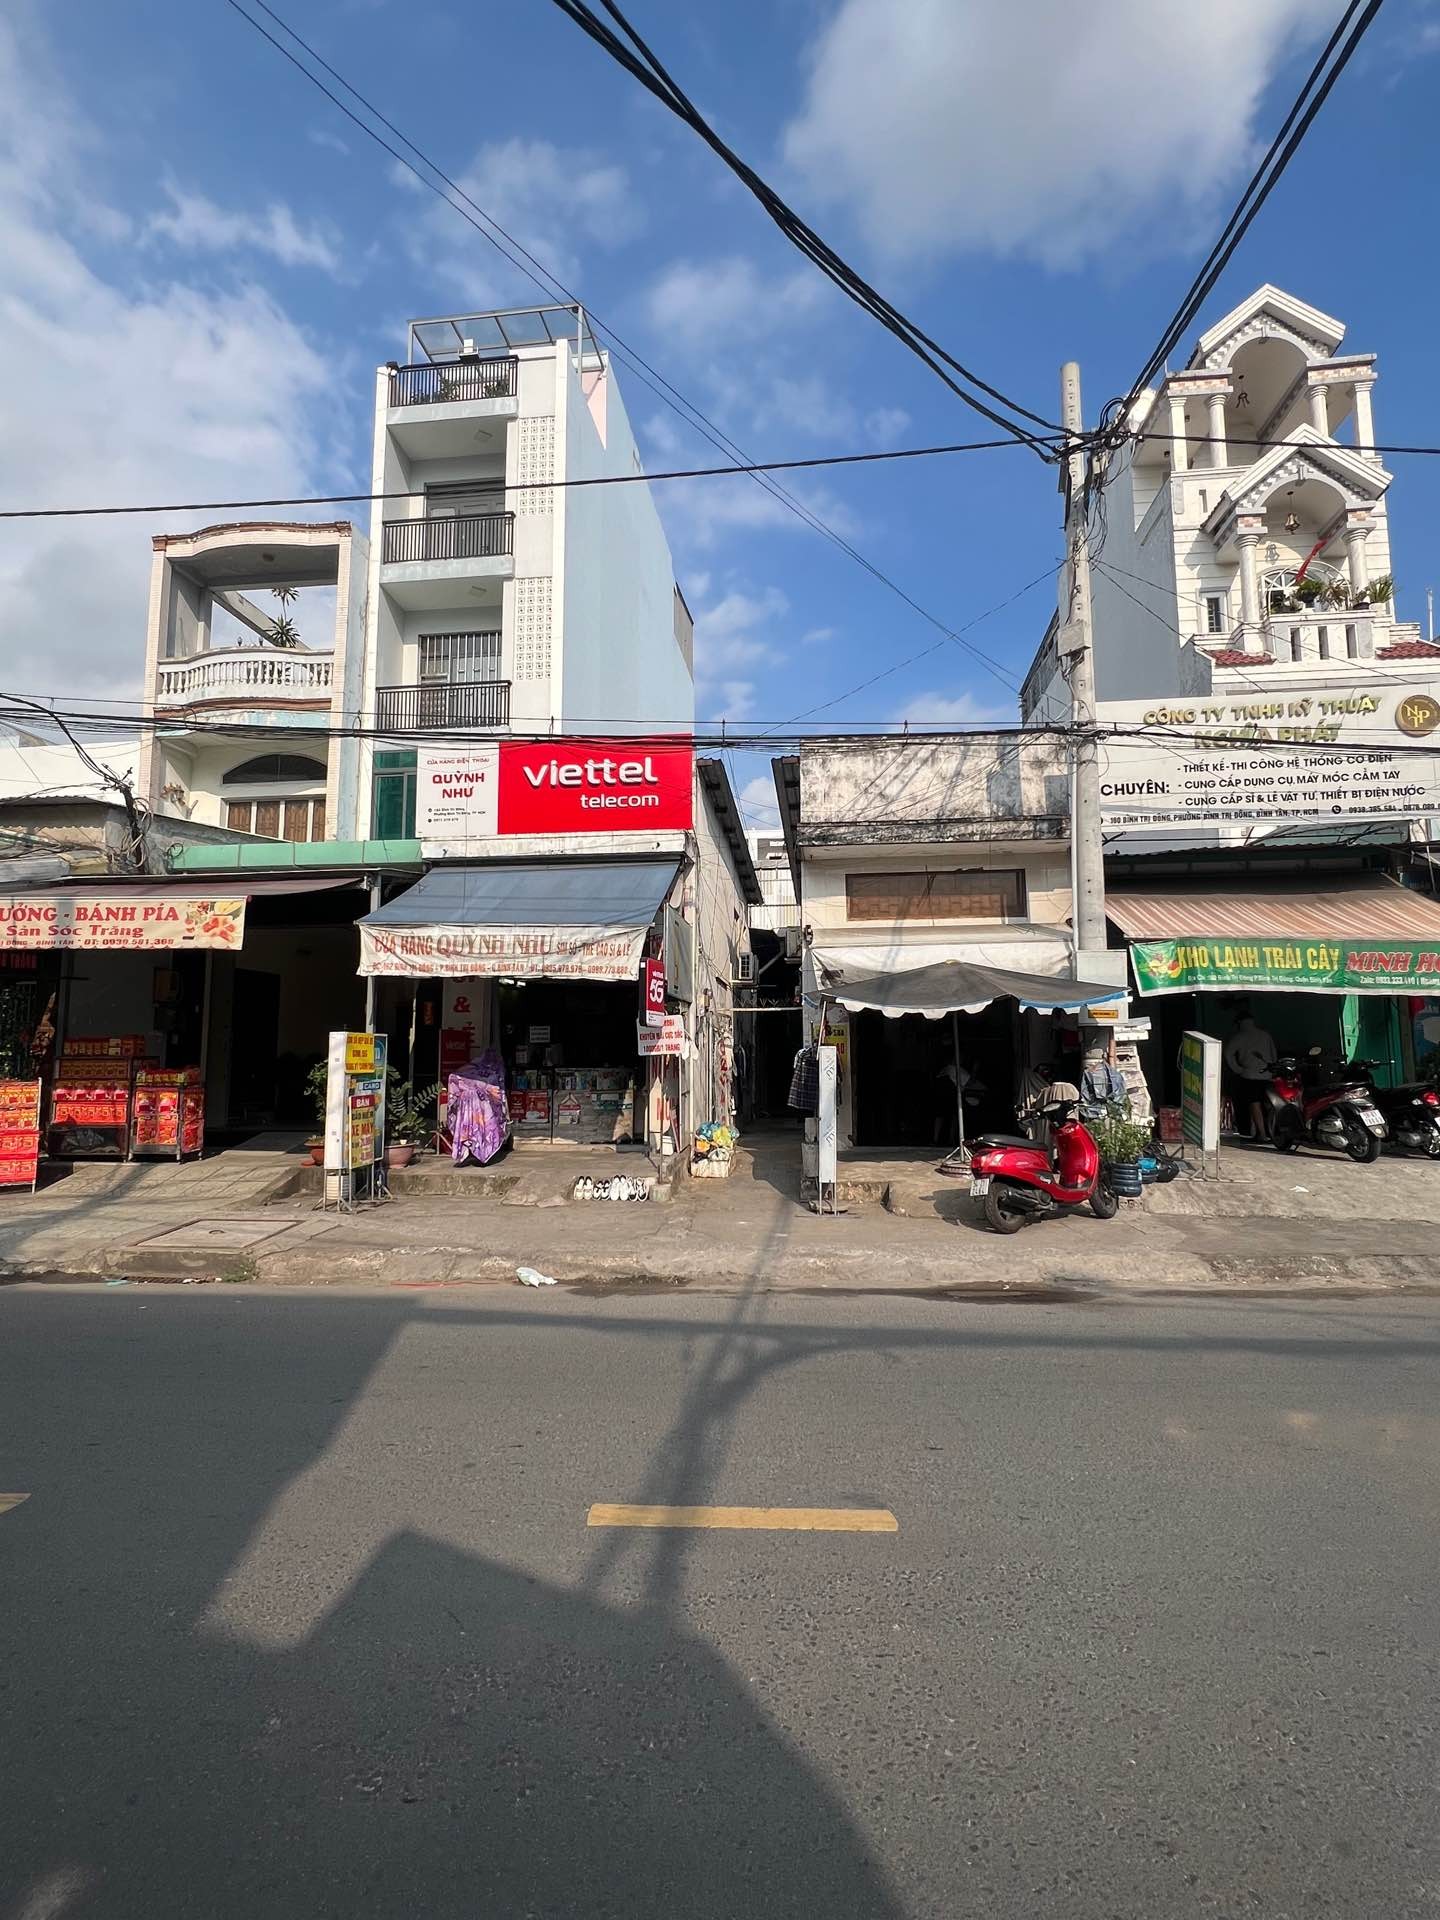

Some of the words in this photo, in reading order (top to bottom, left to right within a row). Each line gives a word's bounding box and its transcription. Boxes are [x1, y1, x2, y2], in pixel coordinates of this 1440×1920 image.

[1143, 706, 1196, 725] CÔNG
[1201, 706, 1225, 723] TY
[1231, 702, 1283, 721] TNHH
[1288, 697, 1313, 717] KỸ
[1318, 693, 1382, 715] THUẬT
[1278, 718, 1342, 742] PHÁT
[1184, 758, 1209, 773] THIẾT
[1212, 758, 1225, 772] KẾ
[1231, 761, 1247, 770] THI
[1249, 756, 1284, 769] CÔNG
[1286, 756, 1300, 769] HỆ
[1303, 752, 1343, 767] THỐNG
[1368, 752, 1393, 764] ĐIỆN
[432, 770, 485, 784] QUỲNH
[523, 757, 660, 788] viettel
[1184, 780, 1216, 789] CUNG
[1219, 774, 1242, 788] CẤP
[1297, 771, 1319, 784] MÁY
[1322, 771, 1350, 782] MÓC
[1382, 771, 1401, 780] TAY
[442, 786, 474, 798] NHƯ
[1100, 779, 1170, 796] CHUYÊN:
[1185, 796, 1217, 806] CUNG
[1220, 791, 1243, 804] CẤP
[1256, 795, 1264, 803] &
[1281, 791, 1298, 803] VẬT
[1320, 786, 1348, 800] THIẾT
[1351, 790, 1362, 801] BỊ
[1365, 788, 1389, 800] ĐIỆN
[1392, 783, 1425, 796] NƯỚC
[580, 794, 660, 808] telecom
[1123, 814, 1139, 824] BÌNH
[1203, 811, 1219, 820] BÌNH
[1221, 812, 1232, 820] TRỊ
[1256, 808, 1273, 817] BÌNH
[75, 903, 137, 921] BÁNH
[143, 902, 180, 921] PÍA
[6, 924, 41, 936] Sản
[48, 924, 82, 936] Sóc
[89, 924, 145, 938] Trăng
[374, 931, 396, 953] CỬA
[400, 932, 433, 956] HÀNG
[1177, 945, 1210, 969] KHO
[1214, 944, 1260, 973] LẠNH
[1262, 943, 1303, 969] TRÁI
[1306, 943, 1340, 970] CÂY
[1345, 951, 1413, 973] MINH
[649, 979, 665, 1003] 5G
[453, 996, 471, 1013] &
[356, 1098, 370, 1107] BÁN
